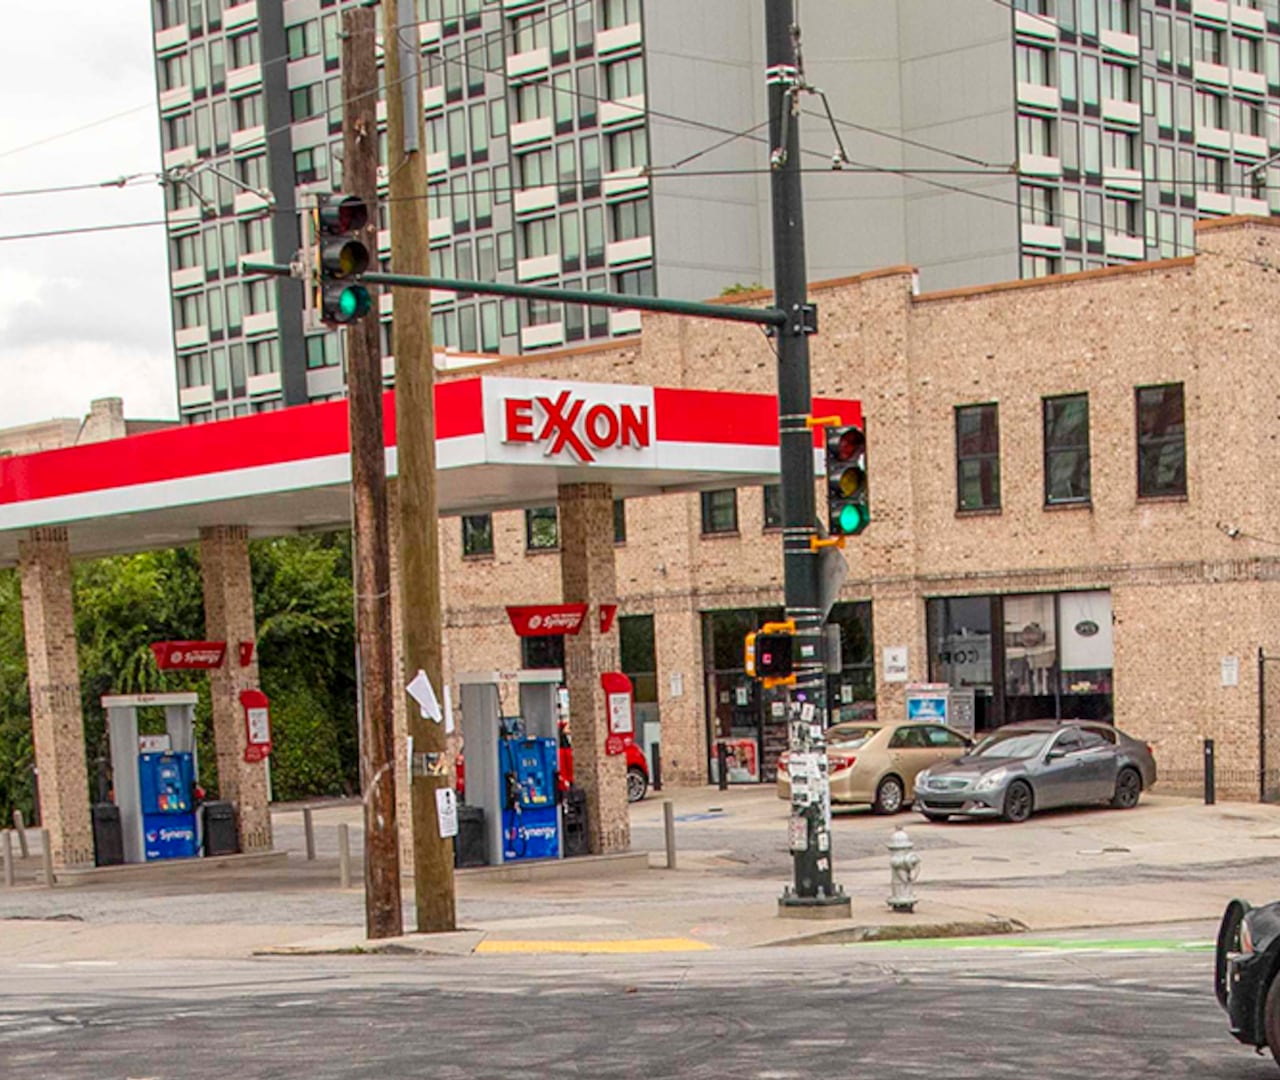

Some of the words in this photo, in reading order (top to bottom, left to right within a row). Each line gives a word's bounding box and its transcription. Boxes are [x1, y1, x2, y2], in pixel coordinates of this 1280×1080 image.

[504, 390, 650, 463] EXXON
[542, 615, 581, 628] Synergy
[183, 653, 220, 664] Synergy
